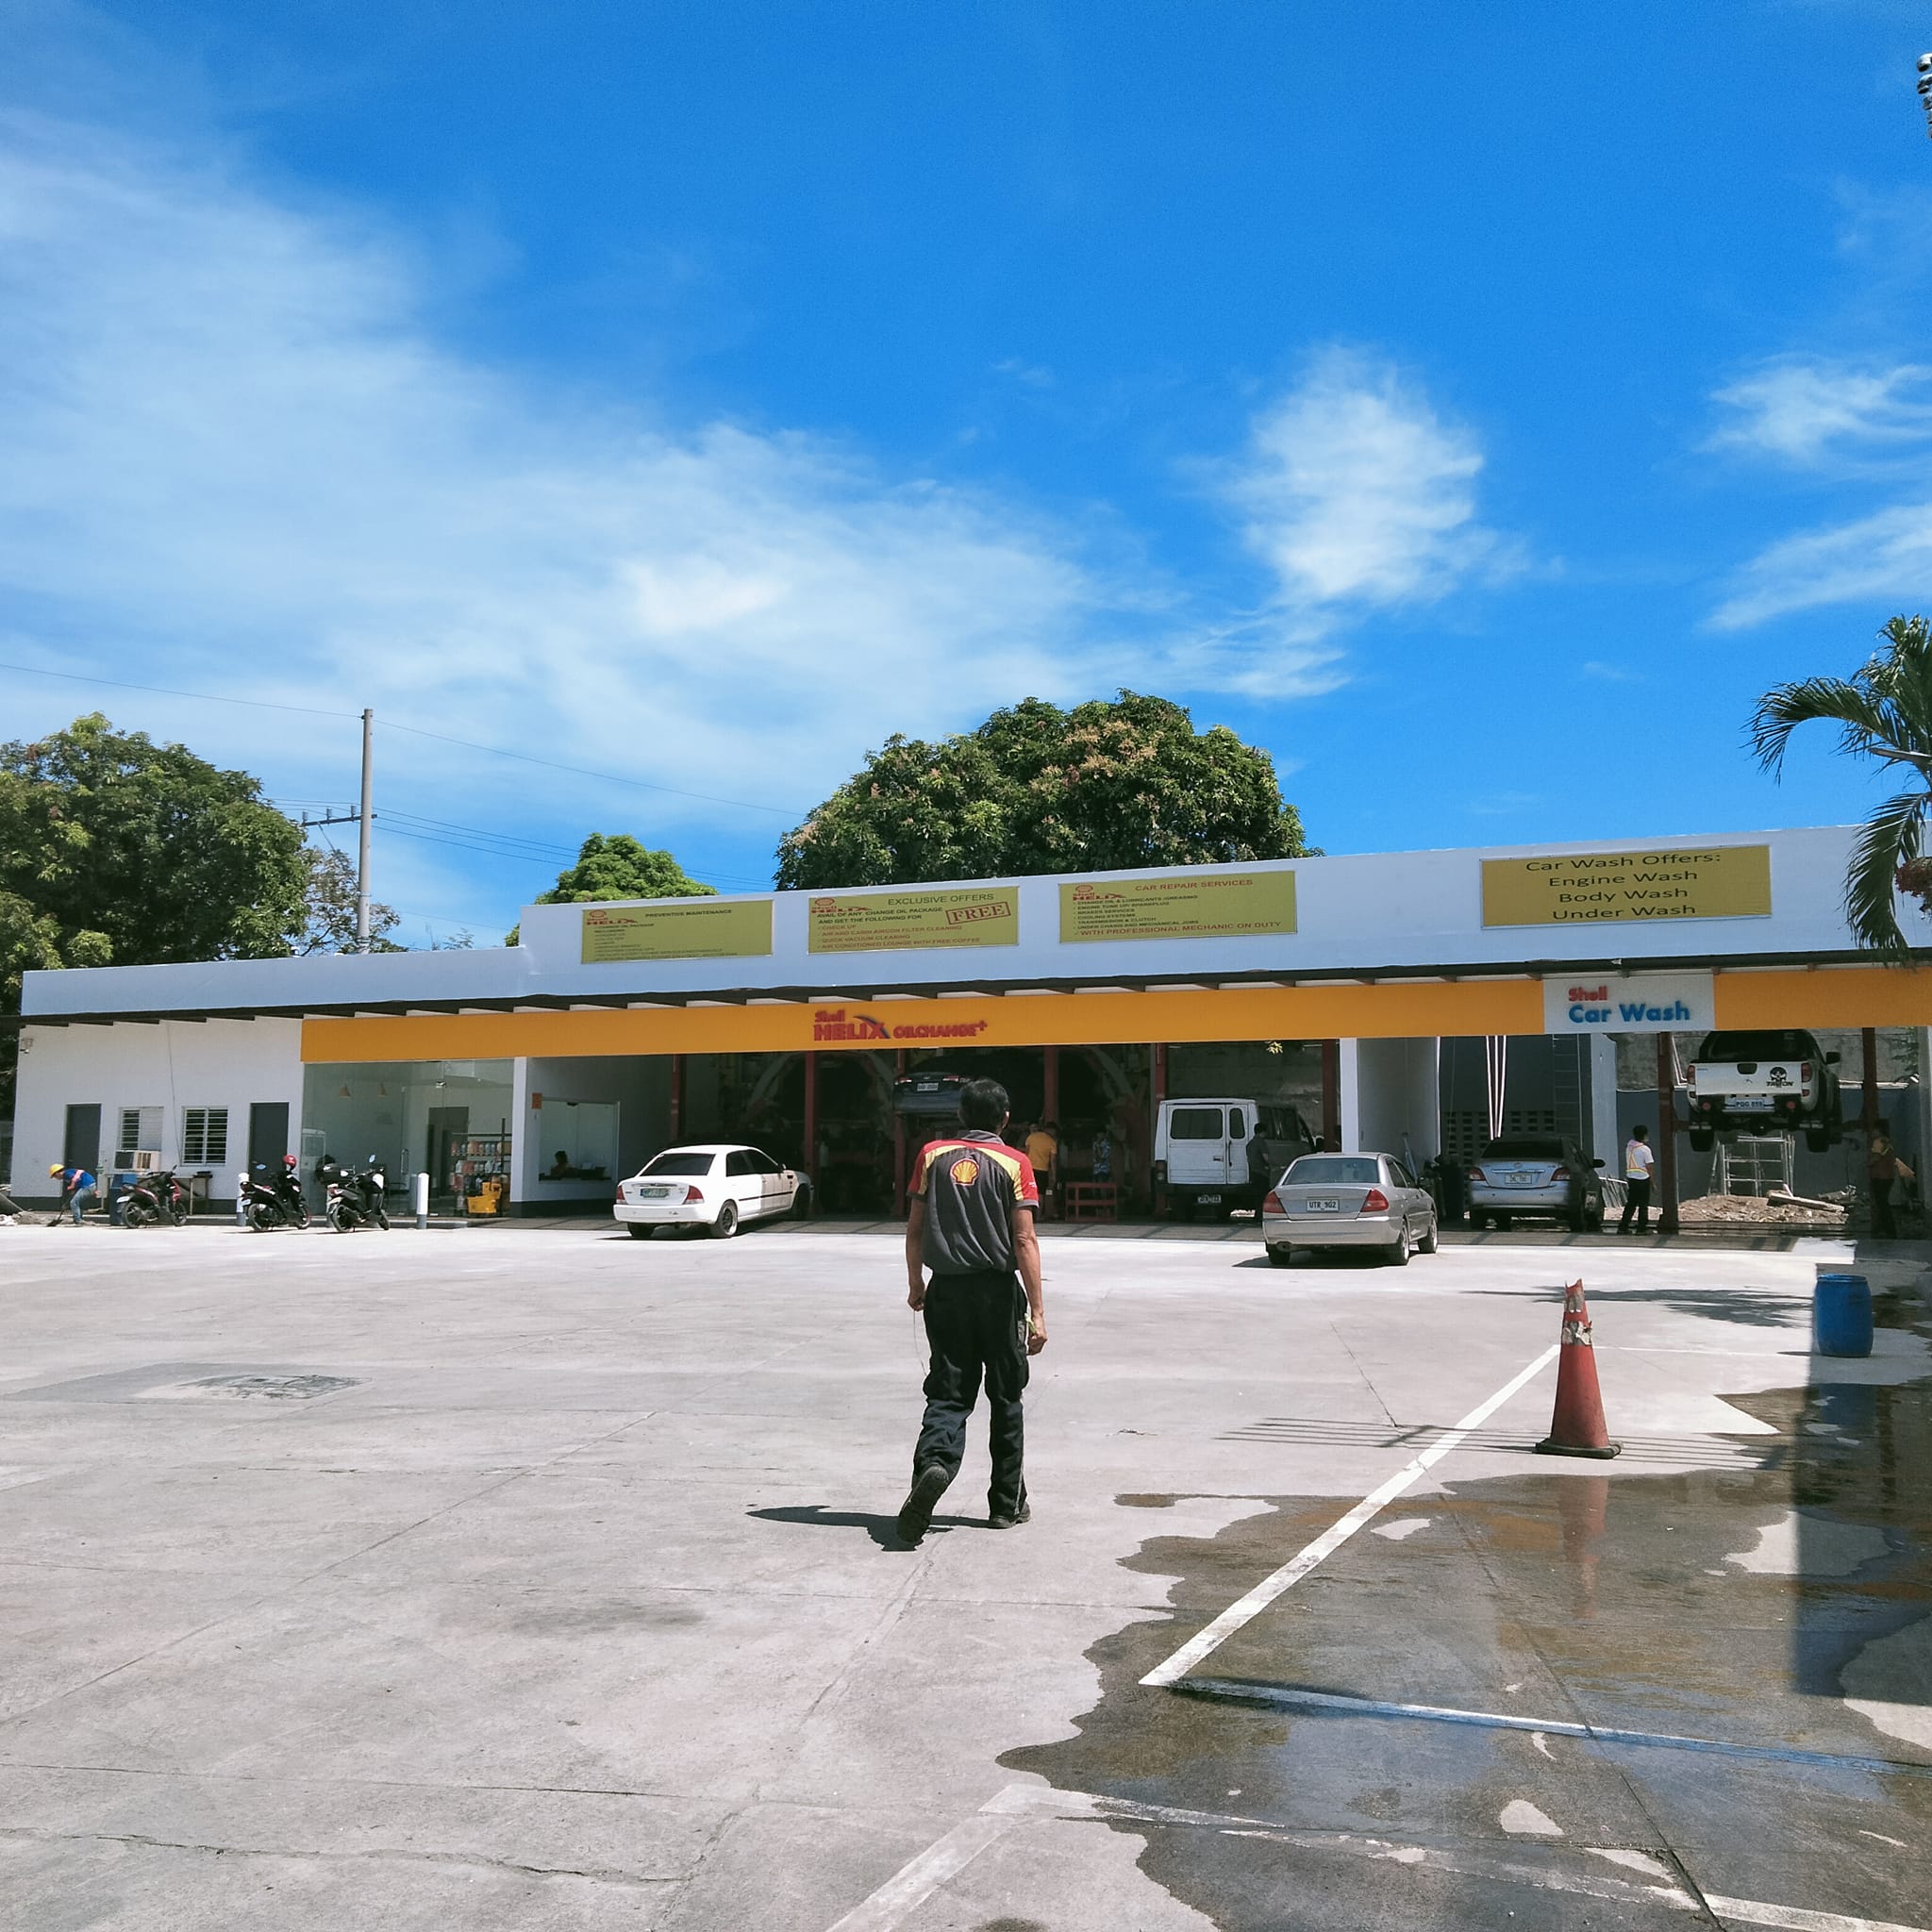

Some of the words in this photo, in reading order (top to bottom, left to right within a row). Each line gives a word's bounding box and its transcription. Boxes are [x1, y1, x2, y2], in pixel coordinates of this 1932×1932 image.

[1525, 861, 1563, 872] Car
[1571, 858, 1633, 869] Wash
[1641, 853, 1722, 865] Offers:
[1200, 879, 1254, 888] SERVICES
[1549, 874, 1625, 888] Engine
[1633, 871, 1698, 882] Wash
[888, 896, 947, 906] EXCLUSIVE
[950, 893, 994, 903] OFFERS
[1559, 891, 1617, 904] Body
[1624, 888, 1688, 900] Wash
[951, 905, 1006, 922] FREE
[1553, 908, 1624, 920] Under
[1631, 905, 1696, 916] Wash
[1107, 926, 1178, 935] PROFESSIONAL
[1568, 985, 1608, 1002] Shell
[814, 1009, 846, 1023] Shell
[1568, 1004, 1612, 1024] Car
[1618, 1000, 1690, 1023] Wash
[813, 1019, 890, 1041] HELIX
